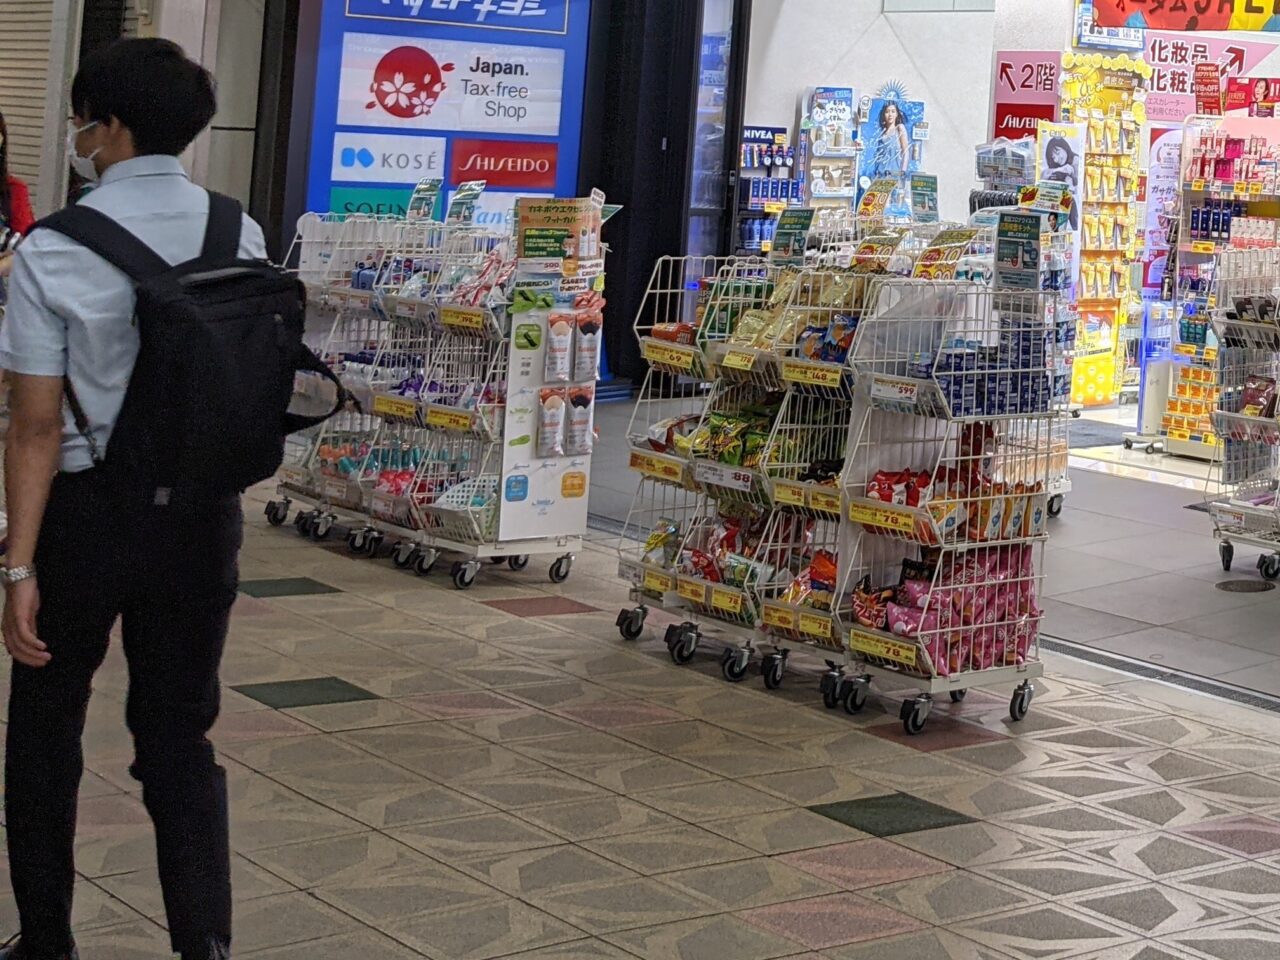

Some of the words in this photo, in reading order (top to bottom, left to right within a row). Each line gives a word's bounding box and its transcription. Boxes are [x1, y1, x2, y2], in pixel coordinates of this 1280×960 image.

[469, 56, 530, 77] Japan.
[1020, 64, 1056, 92] 2階
[1150, 67, 1195, 94] 化粧
[460, 78, 529, 99] Tax-free
[484, 100, 527, 122] Shop
[743, 129, 774, 140] NIVEA
[381, 151, 438, 170] KOSÉ
[459, 153, 550, 173] SHISEIDO
[812, 371, 828, 381] 148
[733, 471, 751, 483] 88
[883, 514, 900, 525] 78
[884, 646, 901, 657] 78
